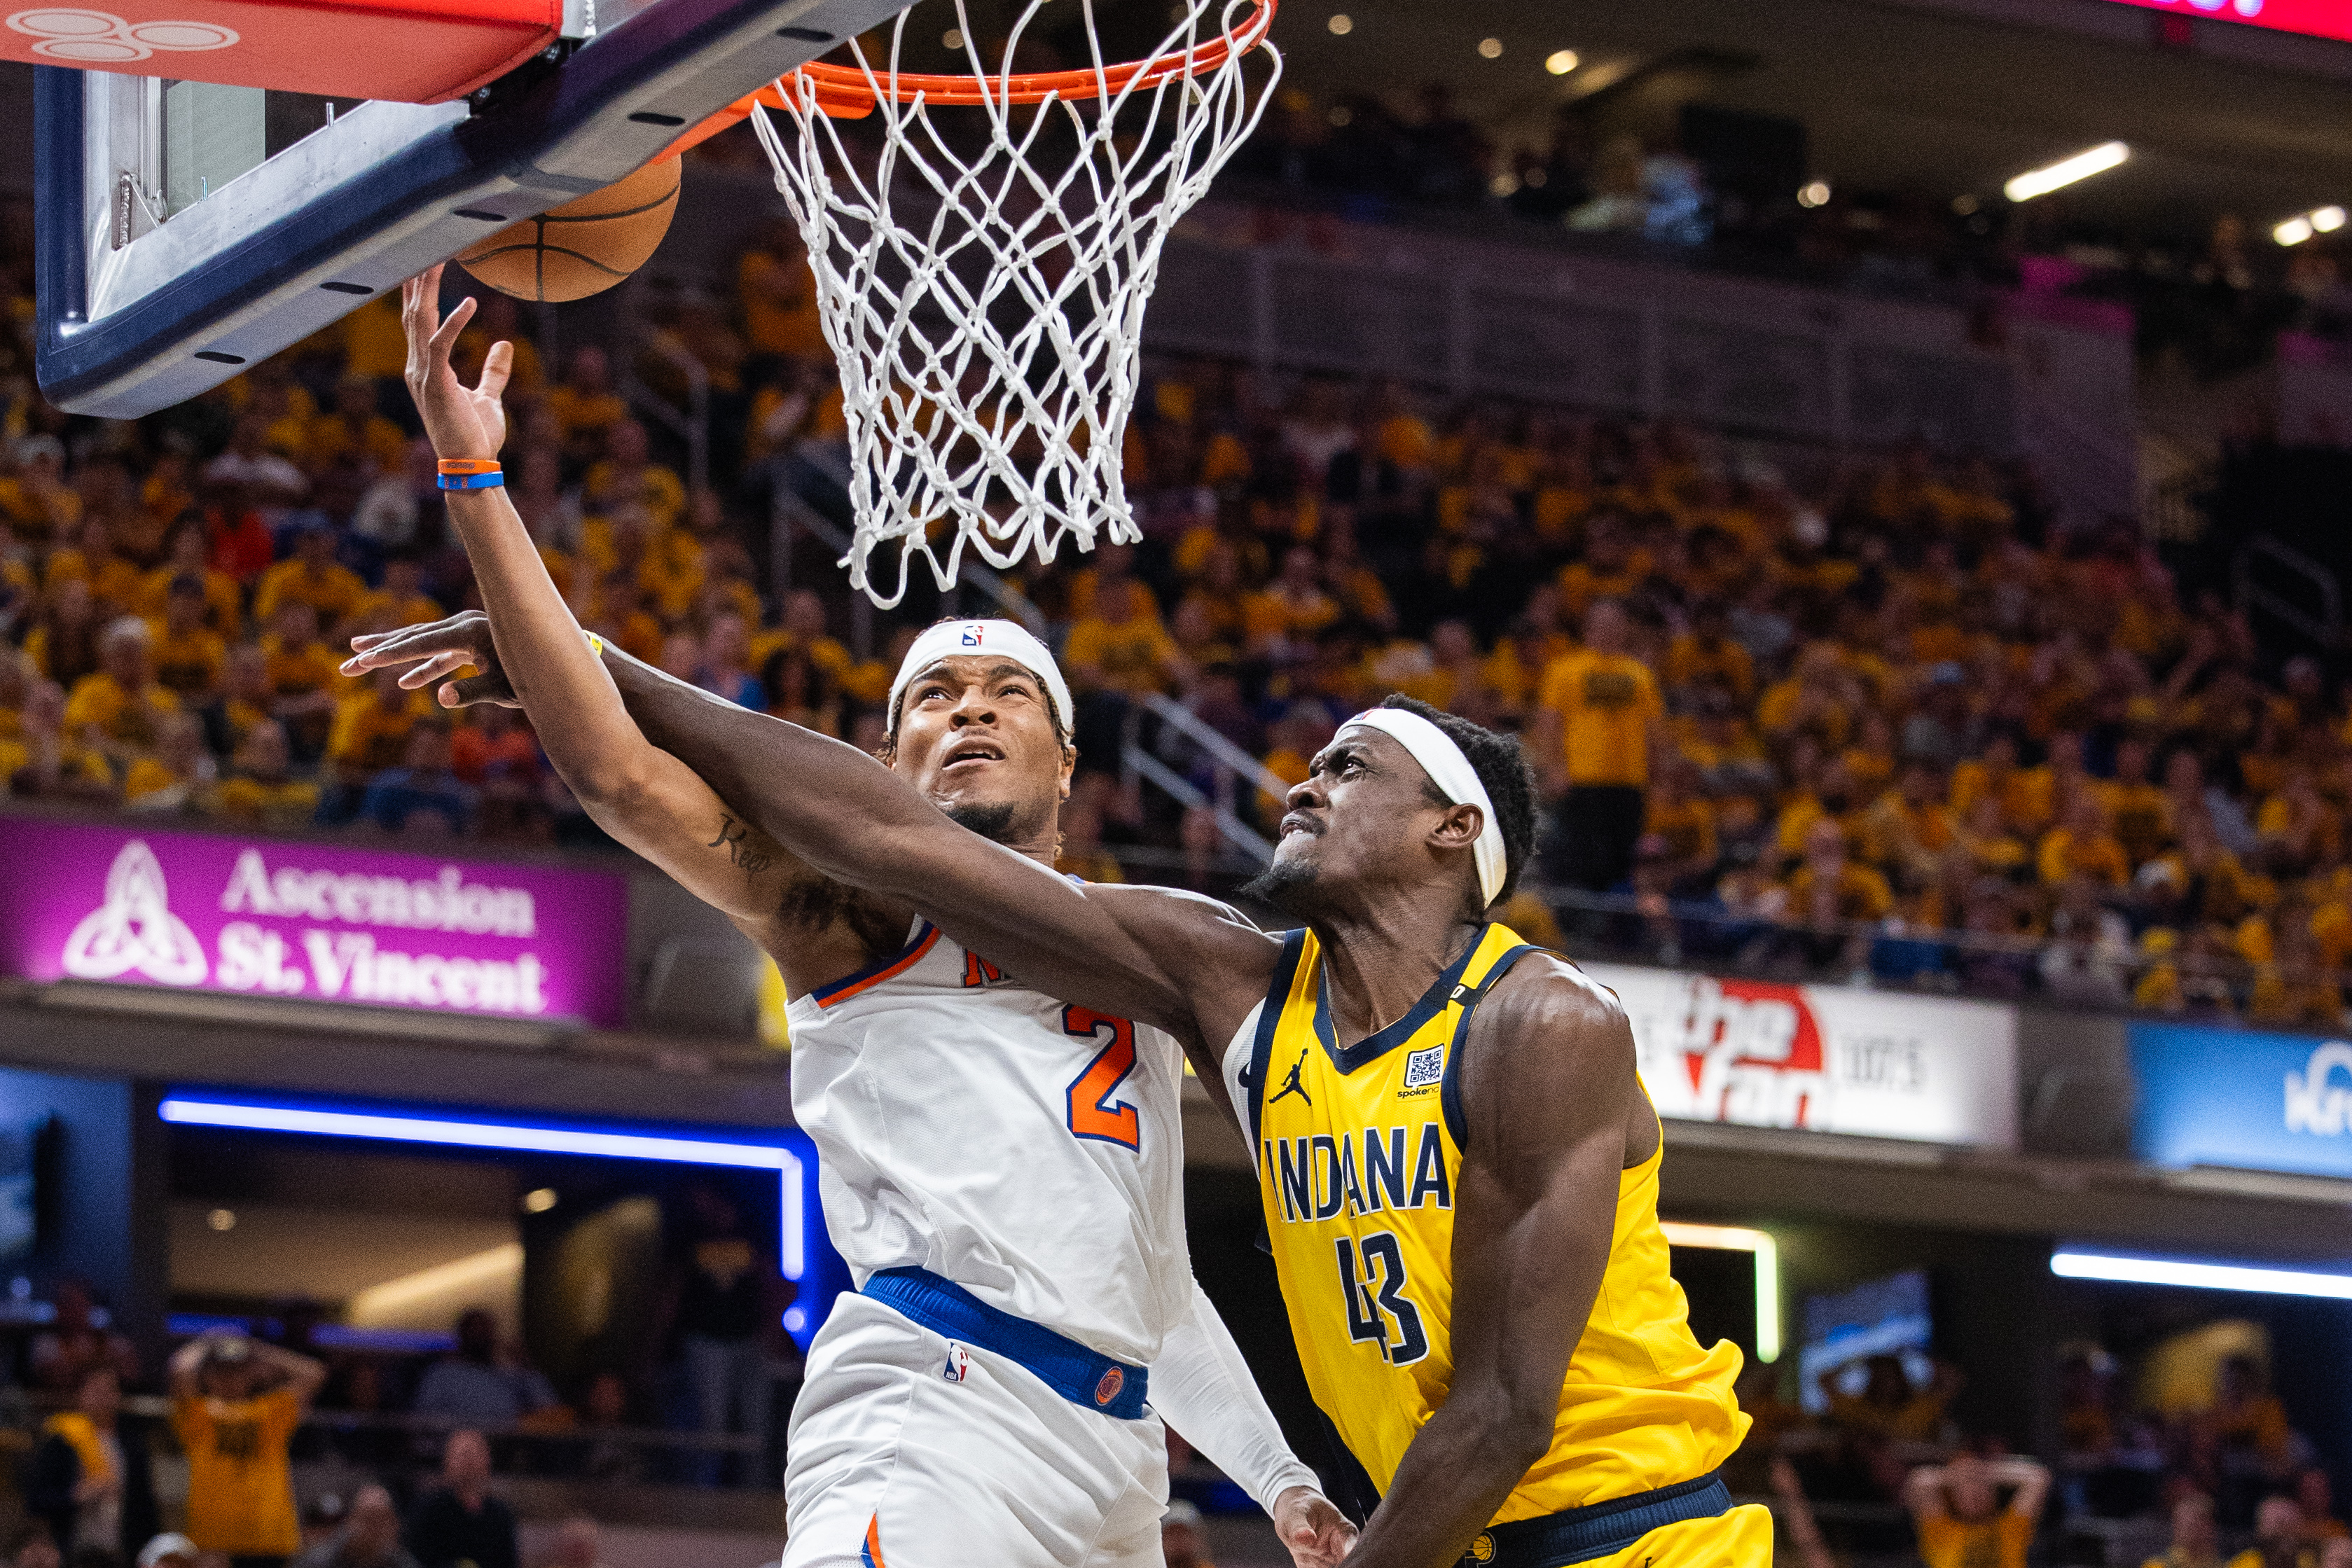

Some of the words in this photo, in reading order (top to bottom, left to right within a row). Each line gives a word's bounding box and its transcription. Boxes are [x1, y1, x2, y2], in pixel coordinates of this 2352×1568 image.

[220, 848, 537, 938] Ascension
[216, 921, 306, 993] St.
[303, 929, 547, 1015] Vincent
[1062, 1004, 1140, 1154] 2
[1334, 1230, 1430, 1367] 43
[946, 1371, 957, 1380] NBA
